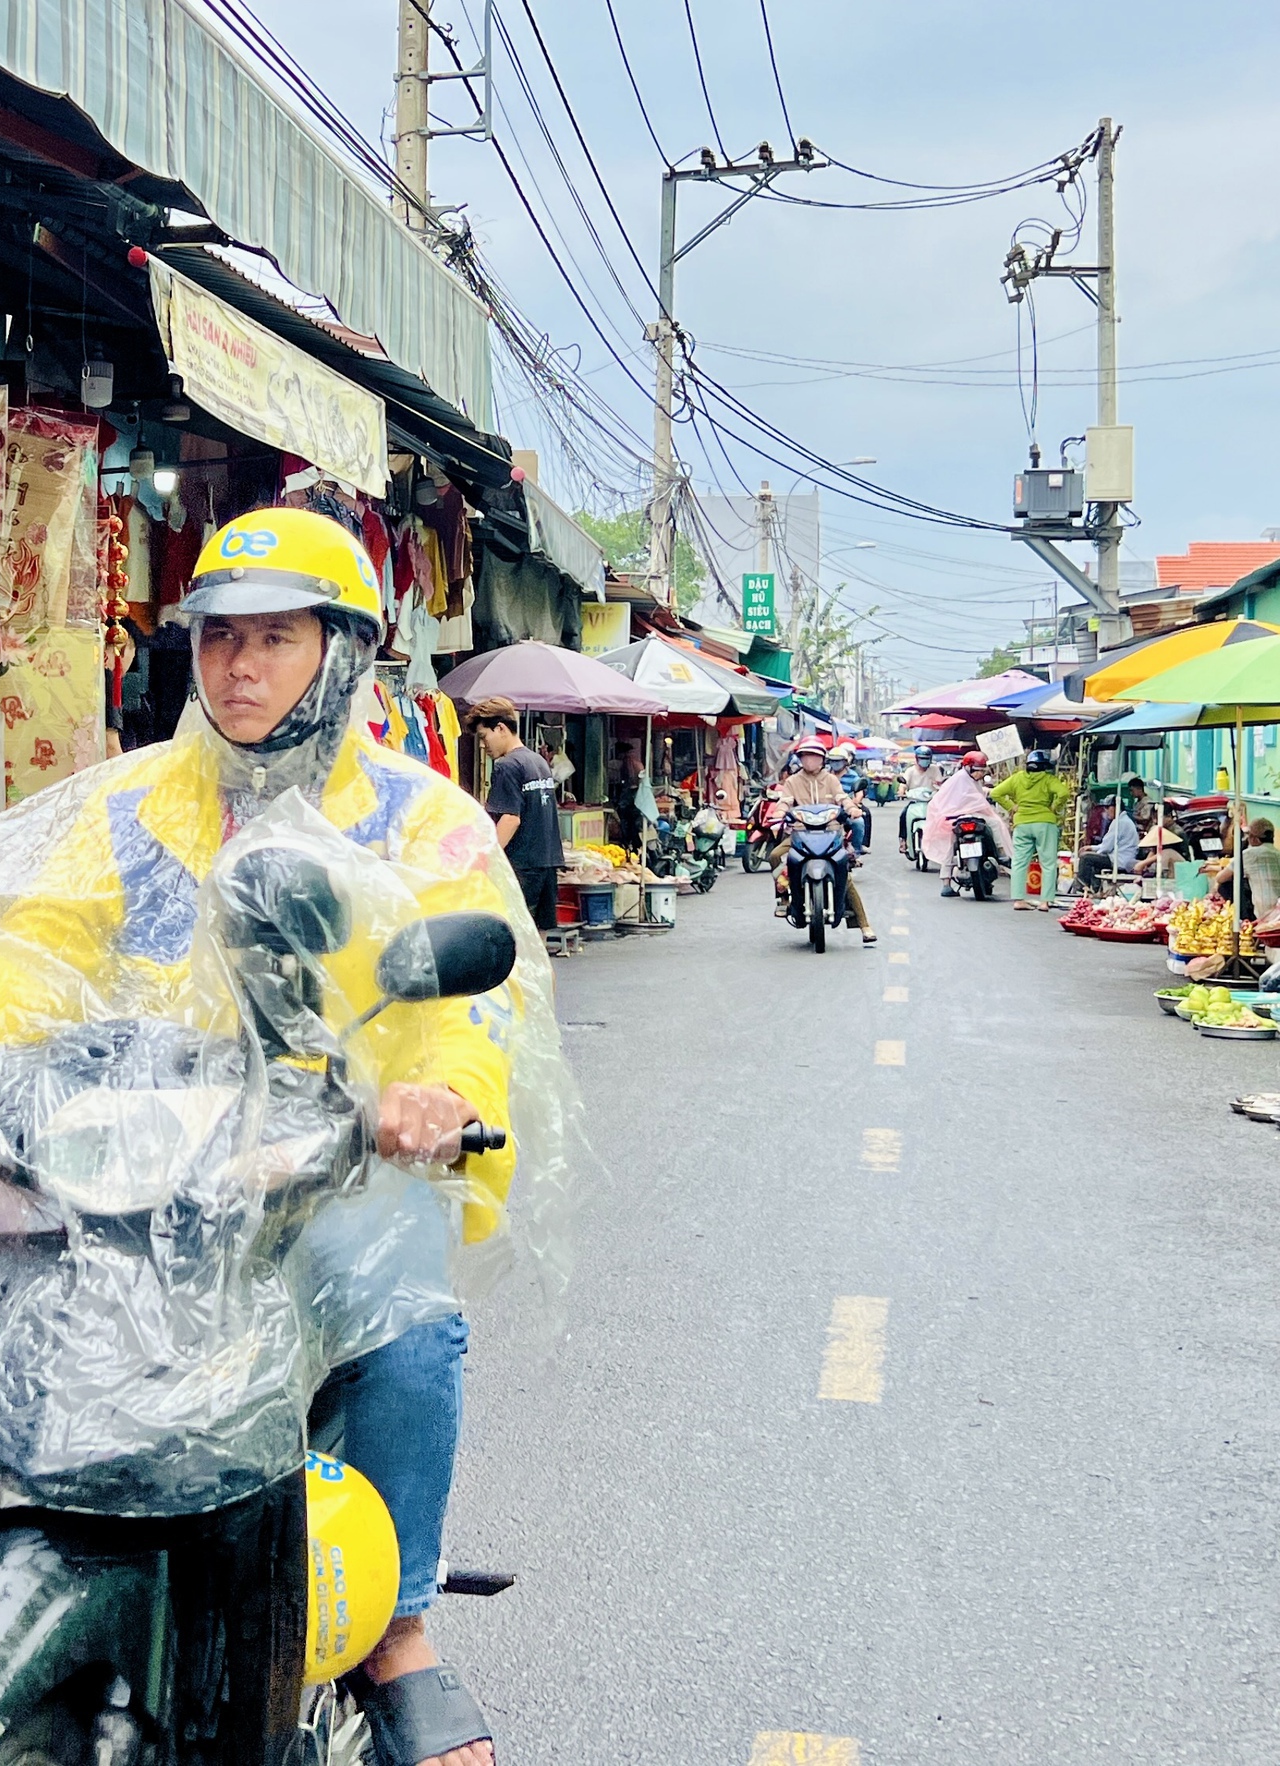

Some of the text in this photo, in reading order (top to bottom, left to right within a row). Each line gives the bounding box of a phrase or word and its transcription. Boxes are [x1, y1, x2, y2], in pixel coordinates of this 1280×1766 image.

[220, 527, 278, 558] be
[351, 544, 375, 588] b
[330, 1546, 346, 1594] GIAO
